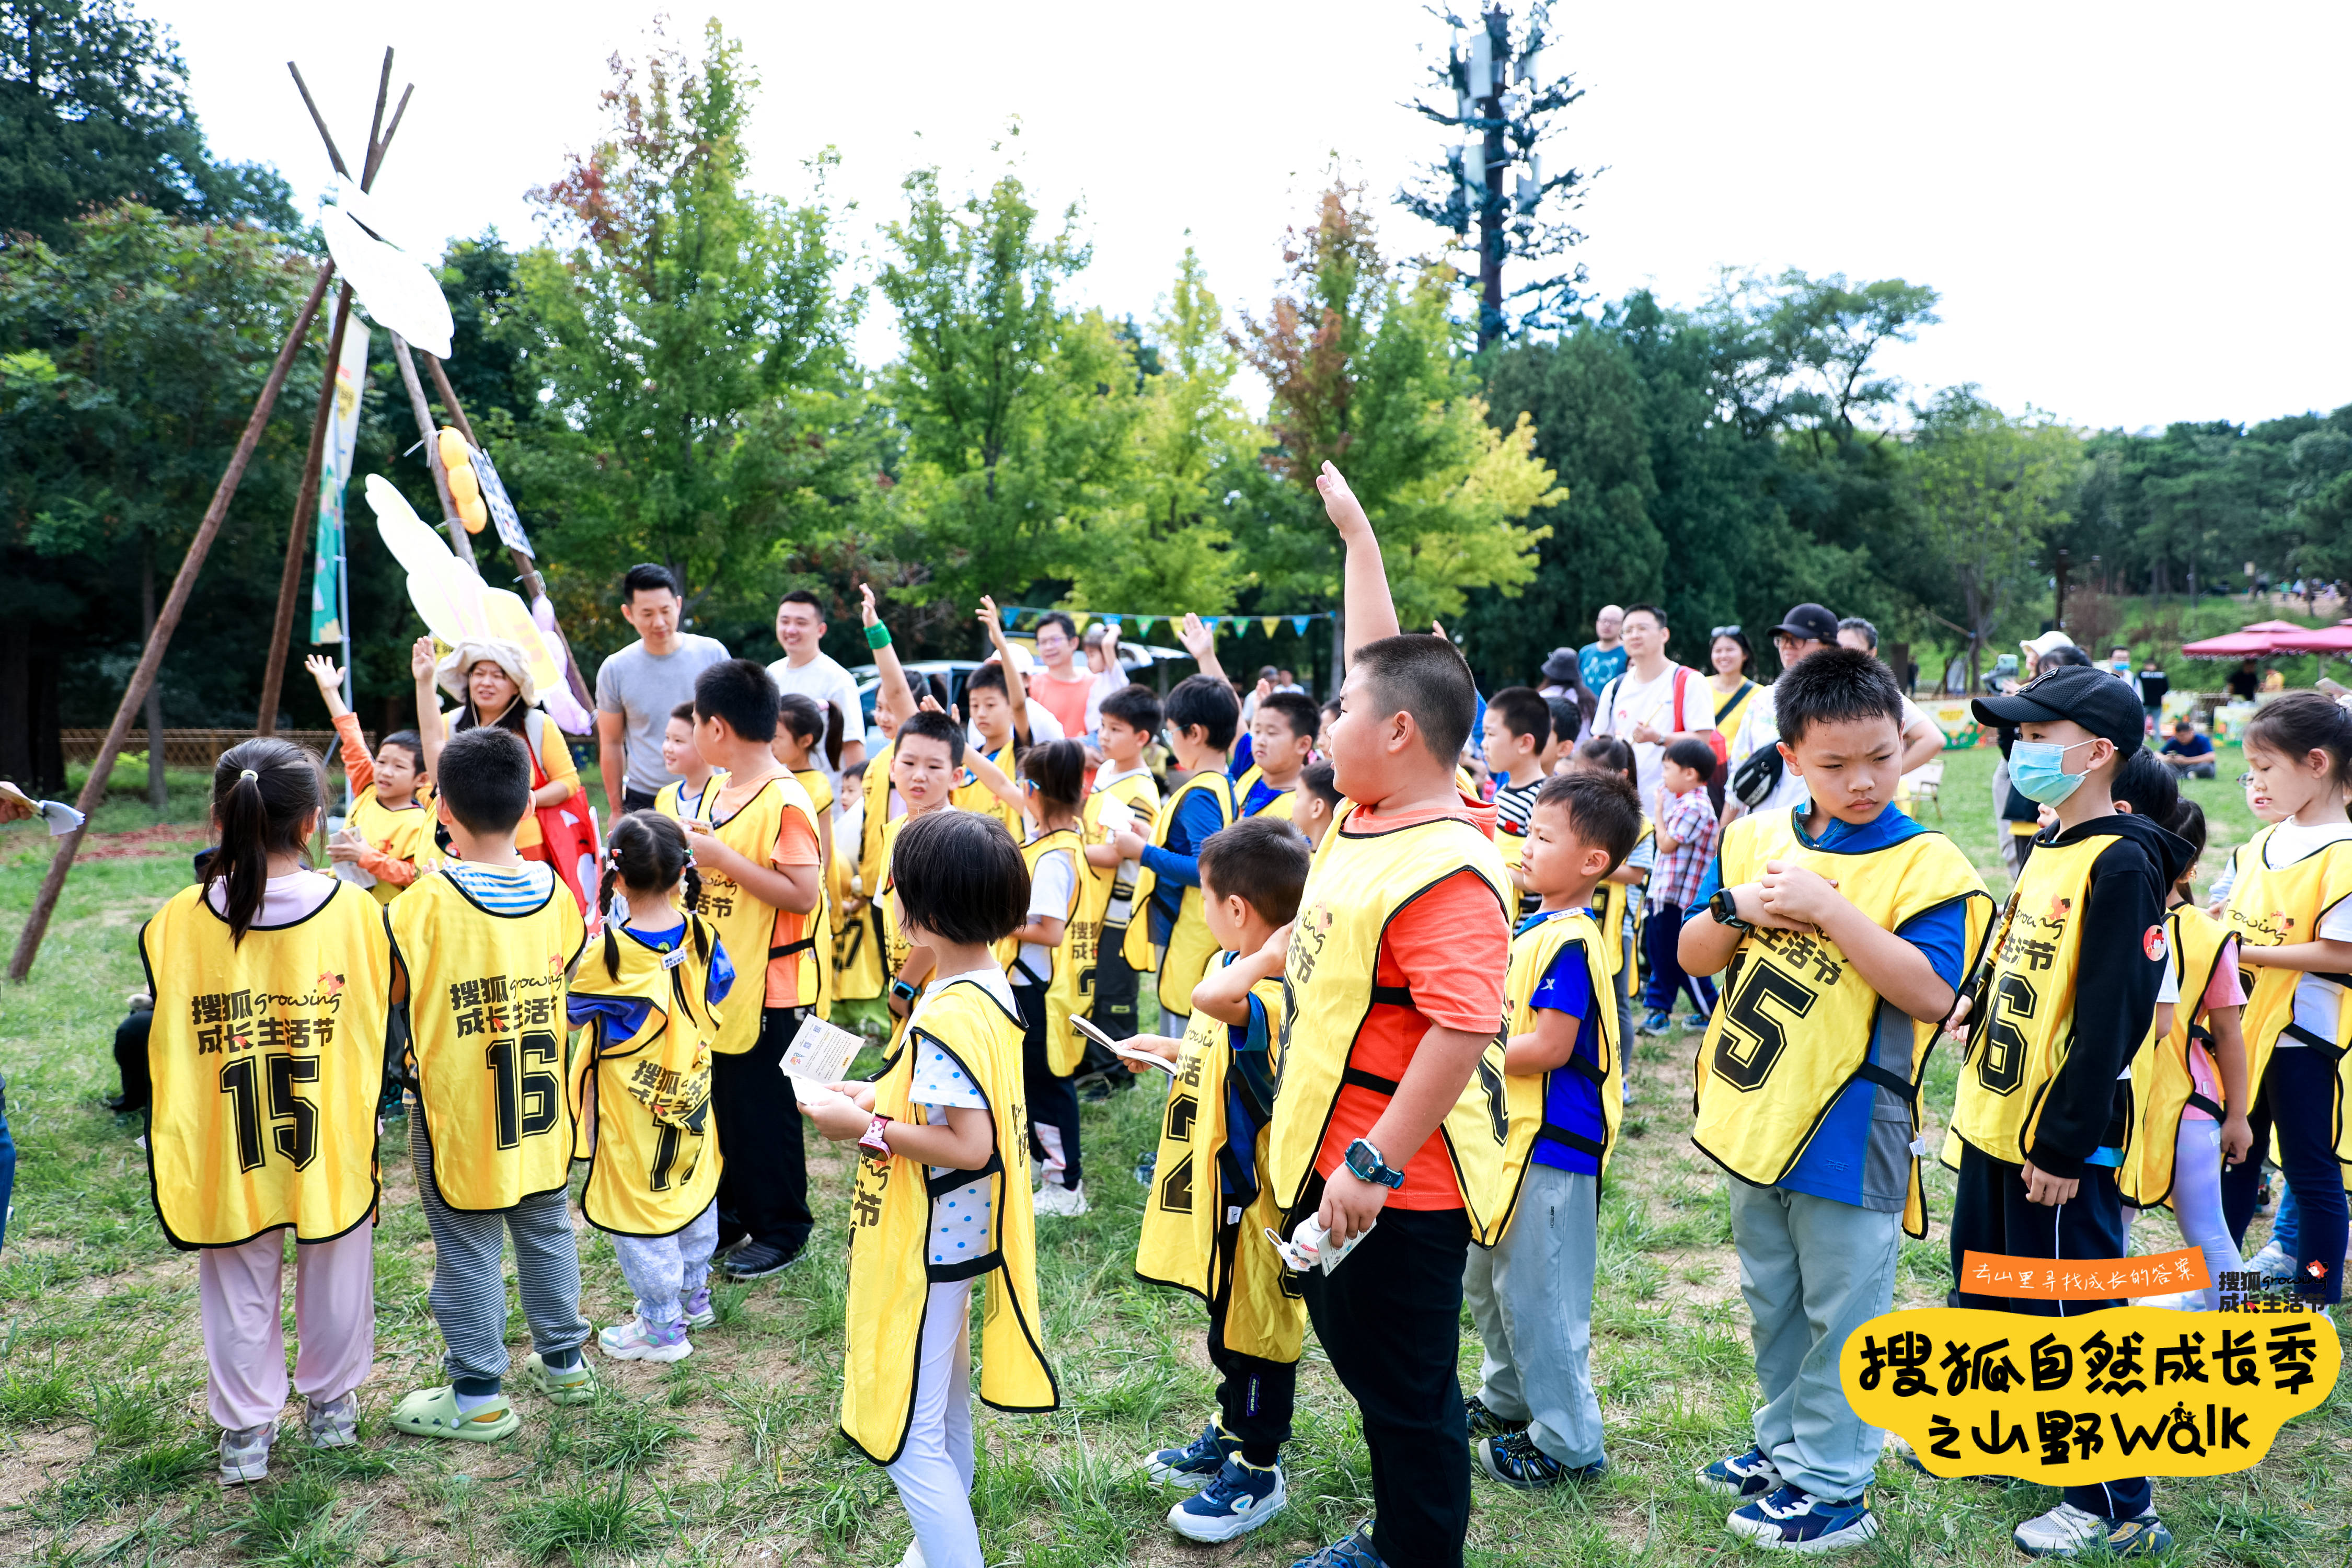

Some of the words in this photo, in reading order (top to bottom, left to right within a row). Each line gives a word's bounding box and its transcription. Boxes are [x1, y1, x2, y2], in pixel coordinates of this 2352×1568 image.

[191, 989, 253, 1025] 搜狐
[254, 989, 342, 1014] growing
[450, 975, 509, 1010] 搜狐
[197, 1017, 335, 1055] 成长生活节
[486, 1030, 559, 1151] 16
[220, 1053, 320, 1174] 15
